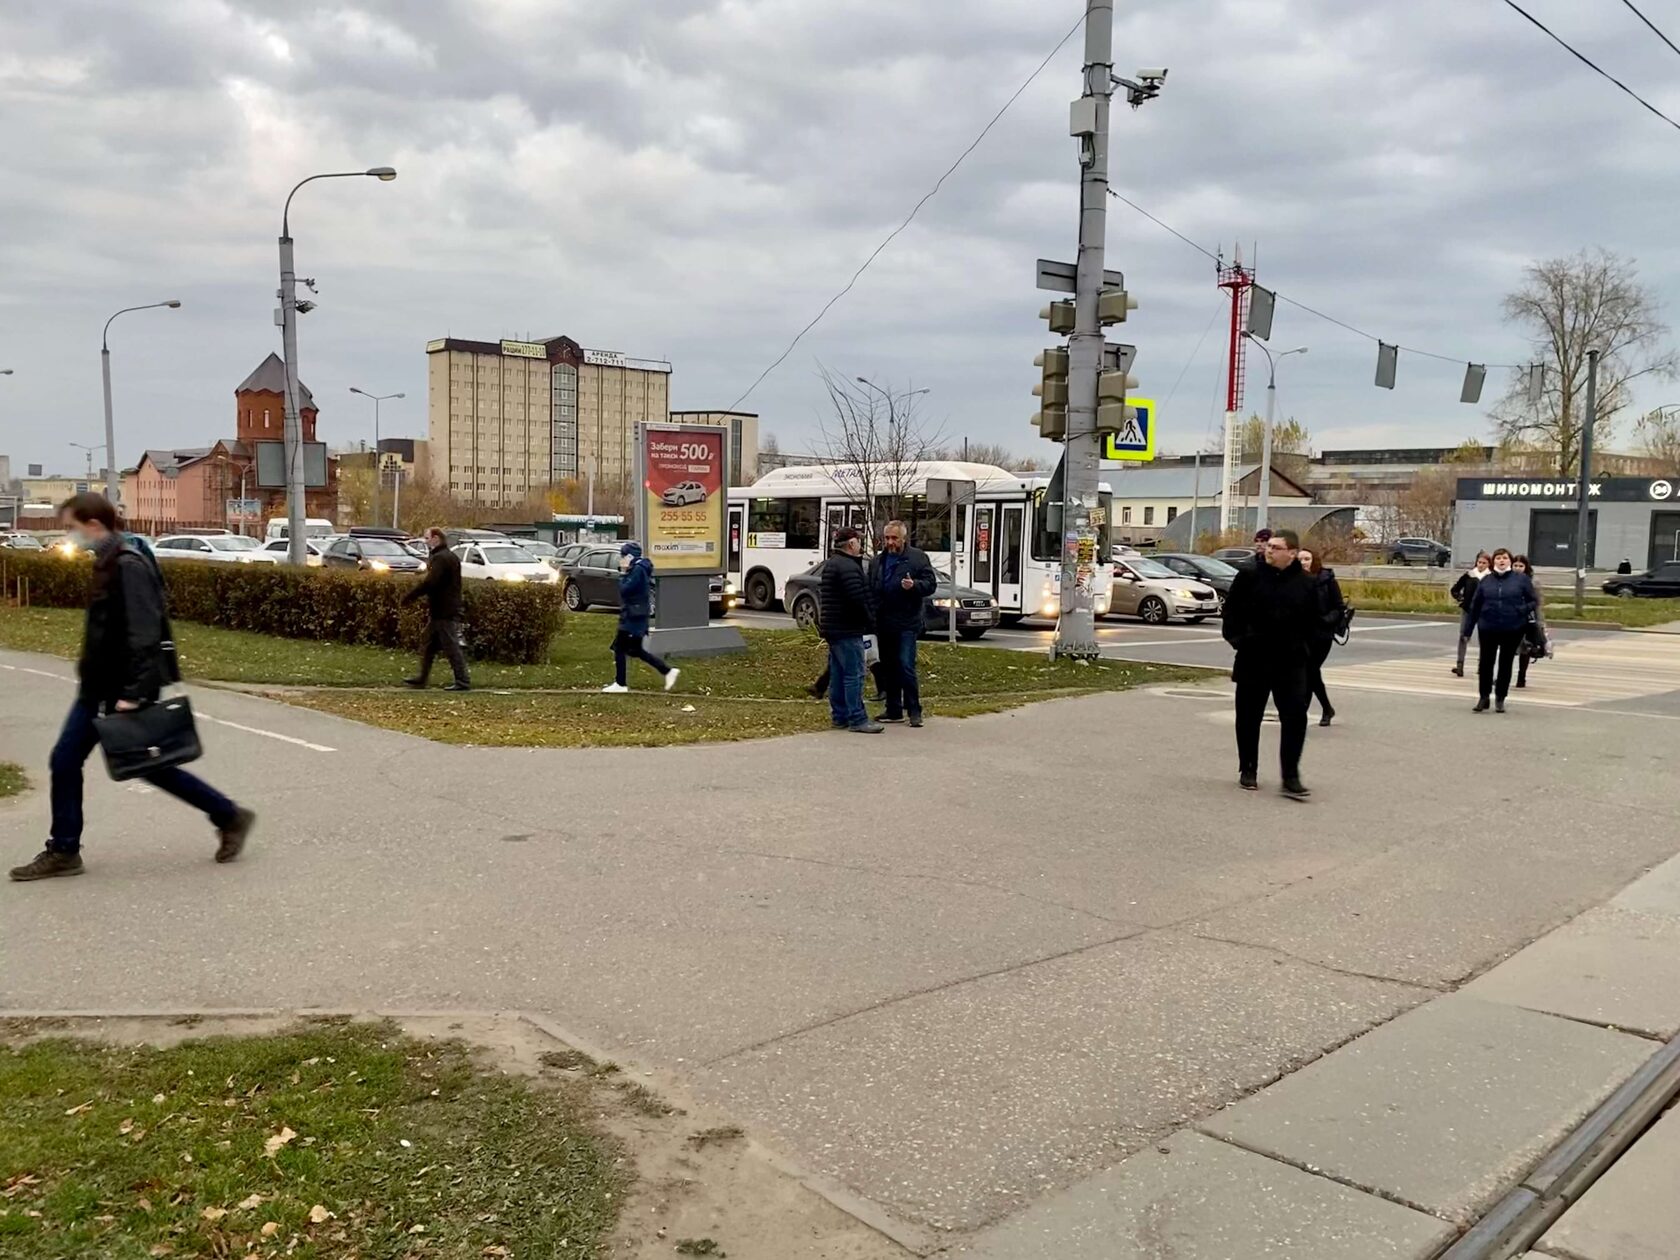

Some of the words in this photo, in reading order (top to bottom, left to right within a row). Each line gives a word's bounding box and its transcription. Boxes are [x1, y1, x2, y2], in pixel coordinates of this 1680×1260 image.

[592, 351, 618, 359] АРЕНДА
[650, 442, 678, 452] Забери
[679, 443, 708, 460] 500
[1483, 483, 1602, 496] ШИНОМОНТЖ
[660, 511, 679, 522] 255
[749, 533, 757, 546] 11
